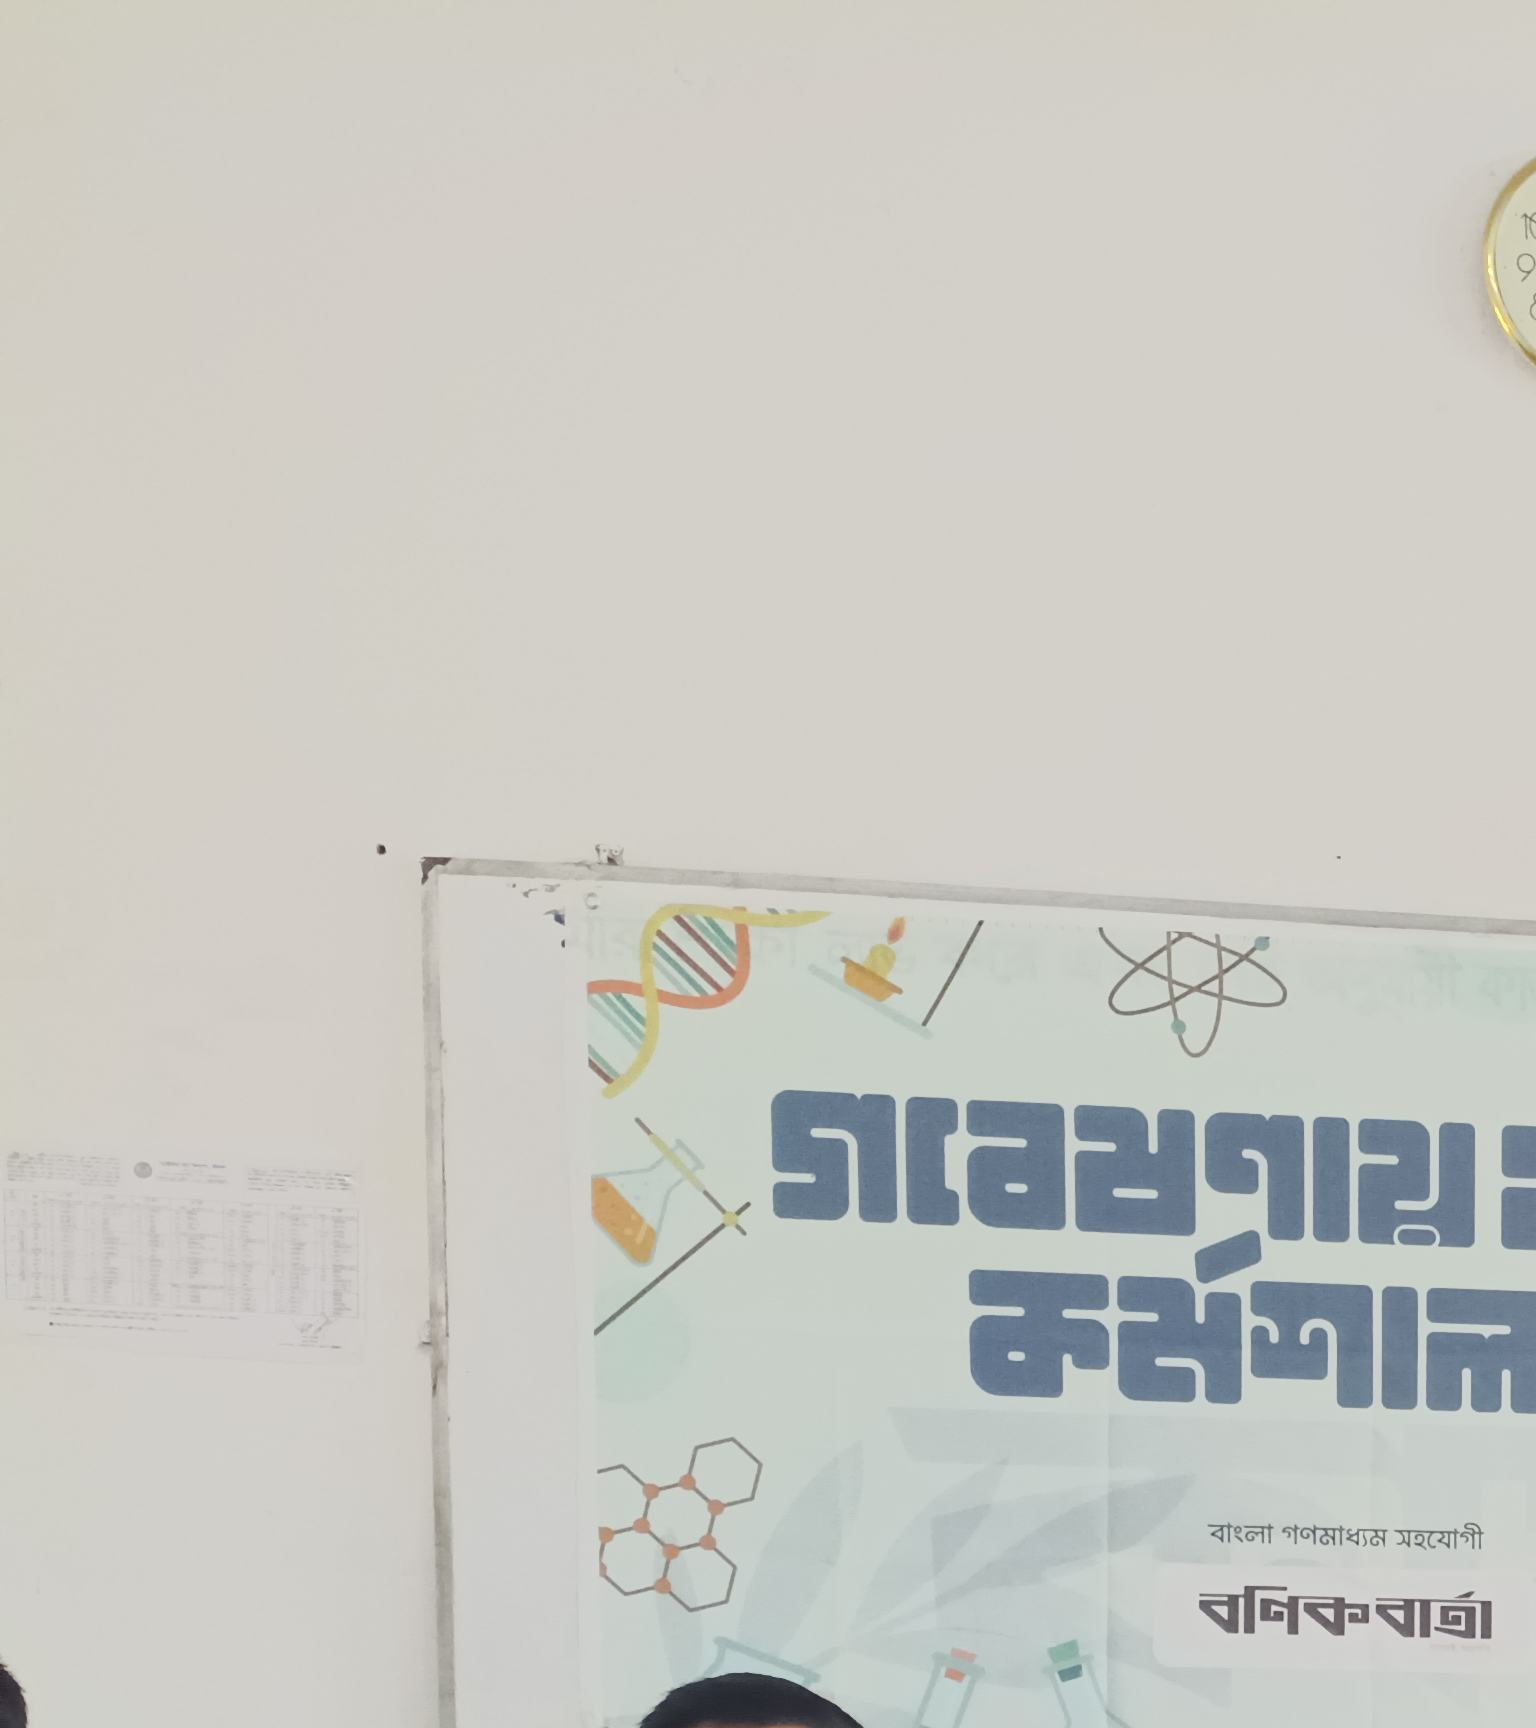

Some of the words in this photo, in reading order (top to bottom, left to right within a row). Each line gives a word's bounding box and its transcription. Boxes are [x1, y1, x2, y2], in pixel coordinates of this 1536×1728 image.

[1515, 253, 1536, 282] 9
[771, 1090, 1475, 1248] গবেষণায়
[1208, 1521, 1273, 1545] বাংলা
[1282, 1524, 1388, 1548] গণমাধ্যম
[1394, 1522, 1484, 1550] সহযোগী
